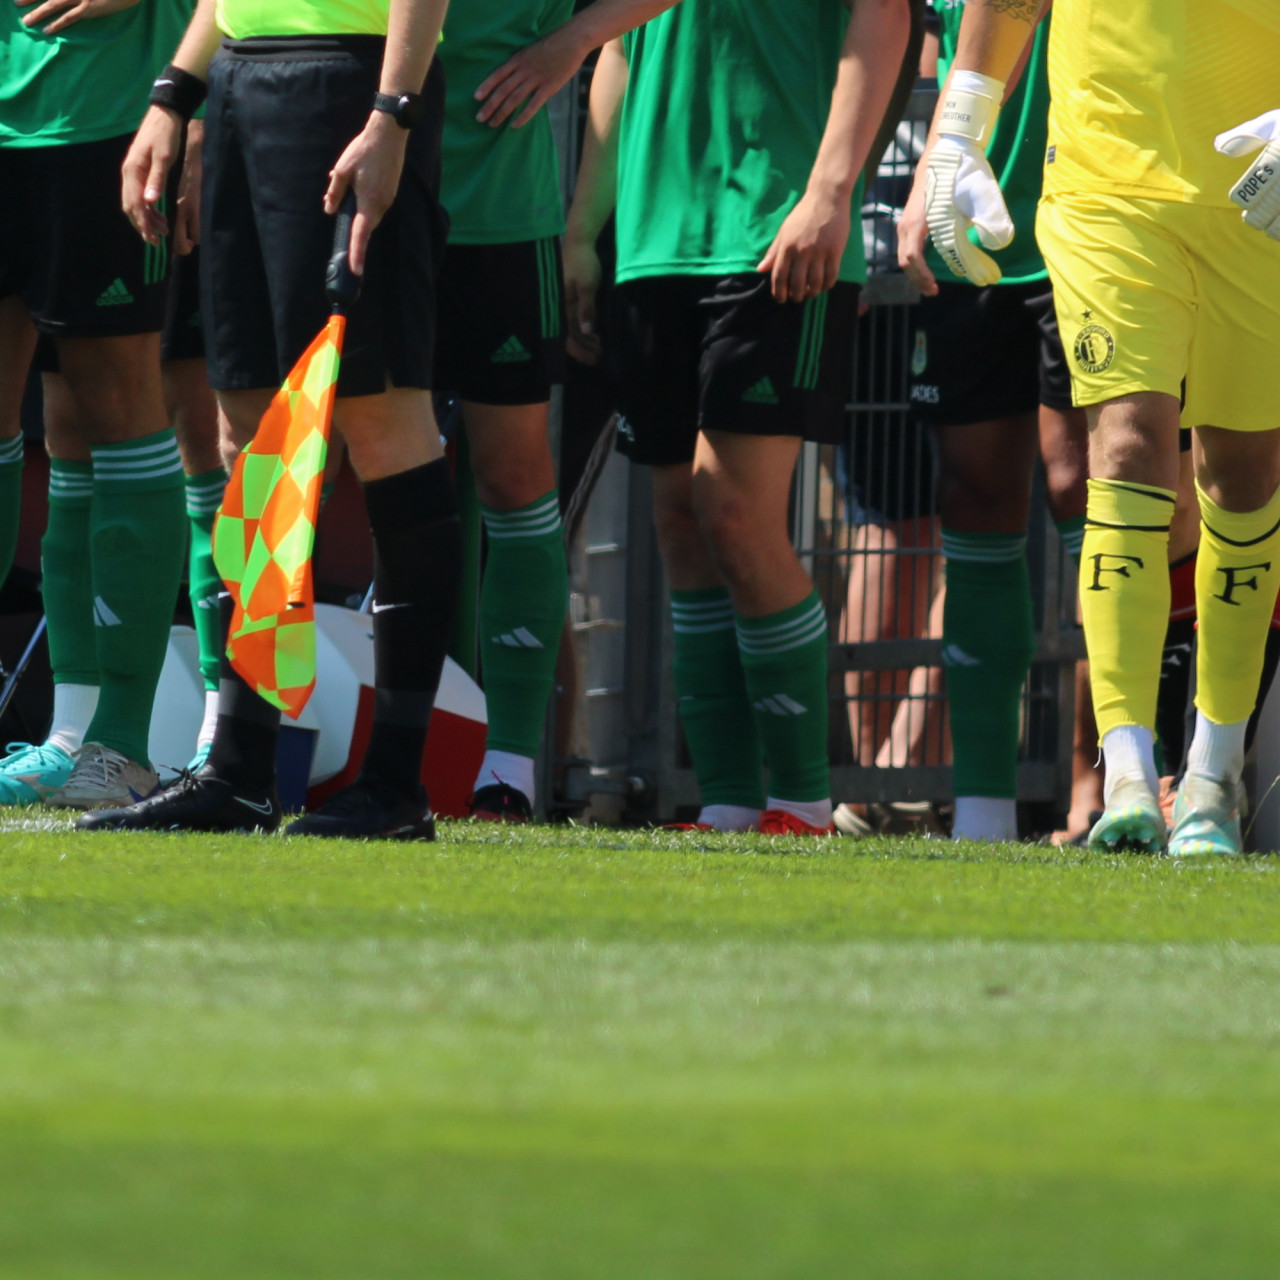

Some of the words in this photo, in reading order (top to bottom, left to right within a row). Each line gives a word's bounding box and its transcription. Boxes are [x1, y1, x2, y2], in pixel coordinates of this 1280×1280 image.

[95, 294, 135, 308] adidas
[1087, 552, 1144, 591] F
[1212, 561, 1272, 606] F
